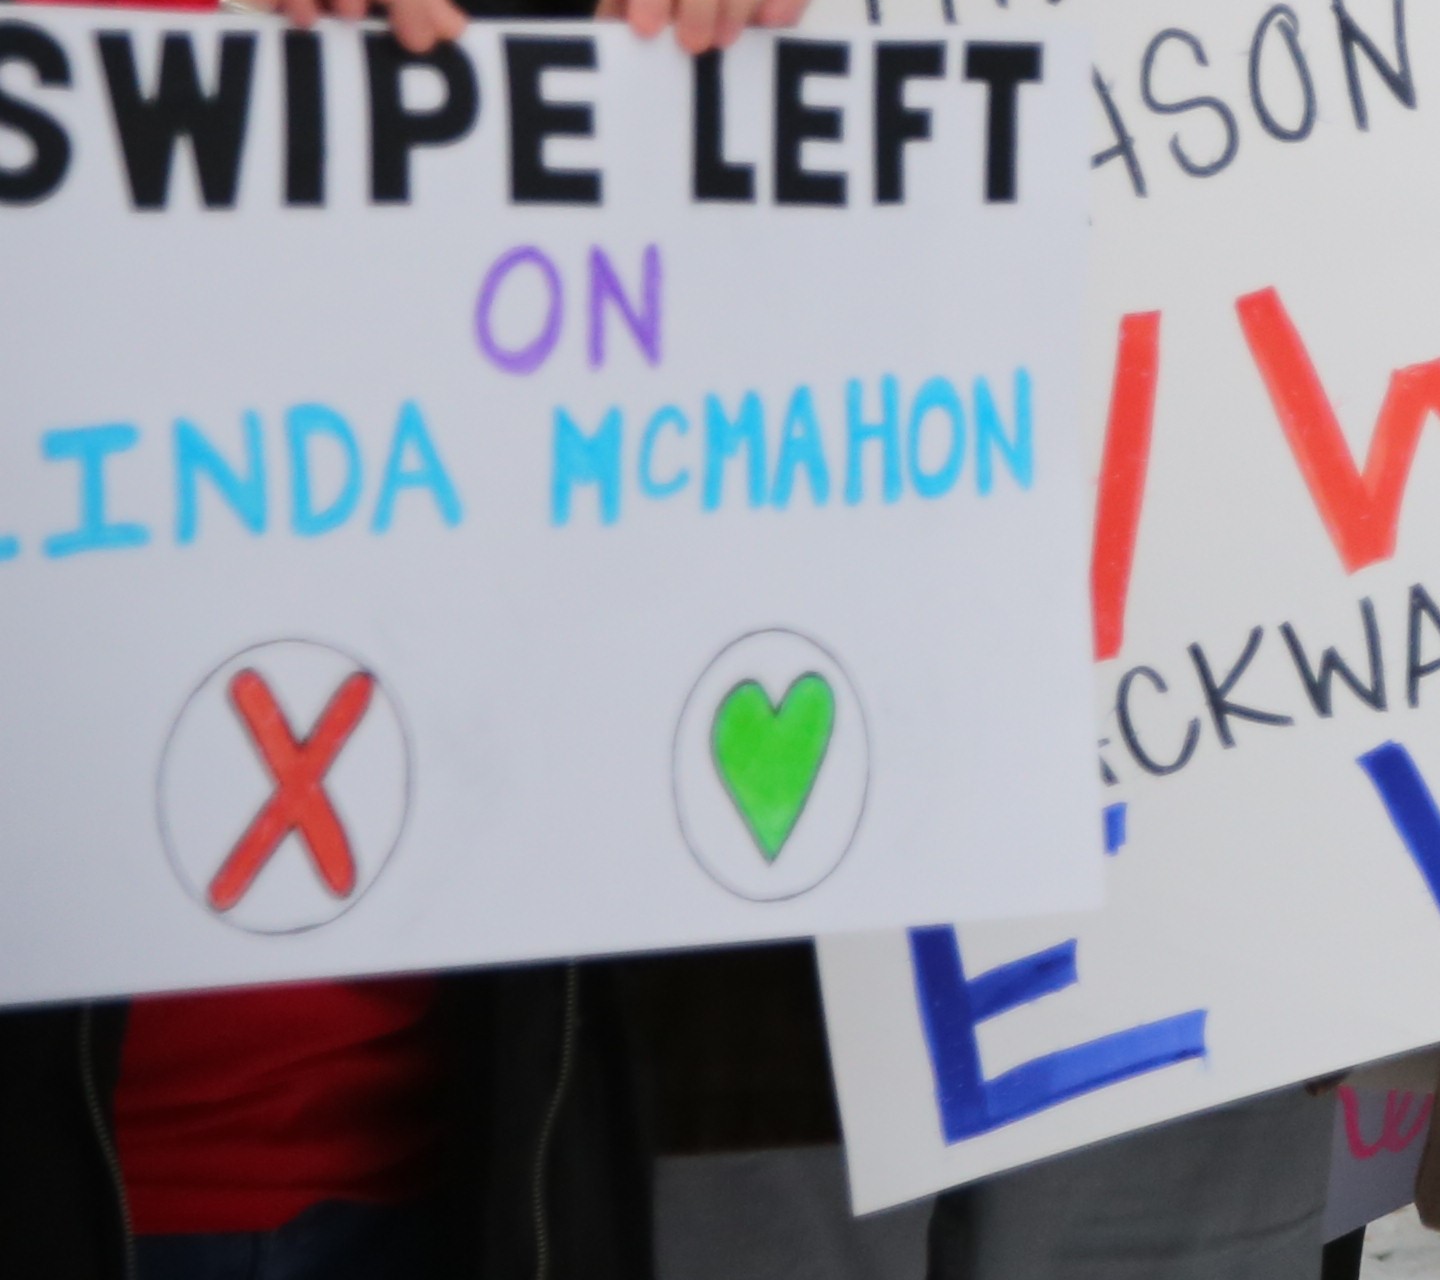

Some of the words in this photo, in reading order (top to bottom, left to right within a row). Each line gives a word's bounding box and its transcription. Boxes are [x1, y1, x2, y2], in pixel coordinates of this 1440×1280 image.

[691, 37, 1044, 207] LEFT
[473, 242, 663, 377] ON
[0, 399, 464, 563] INDA
